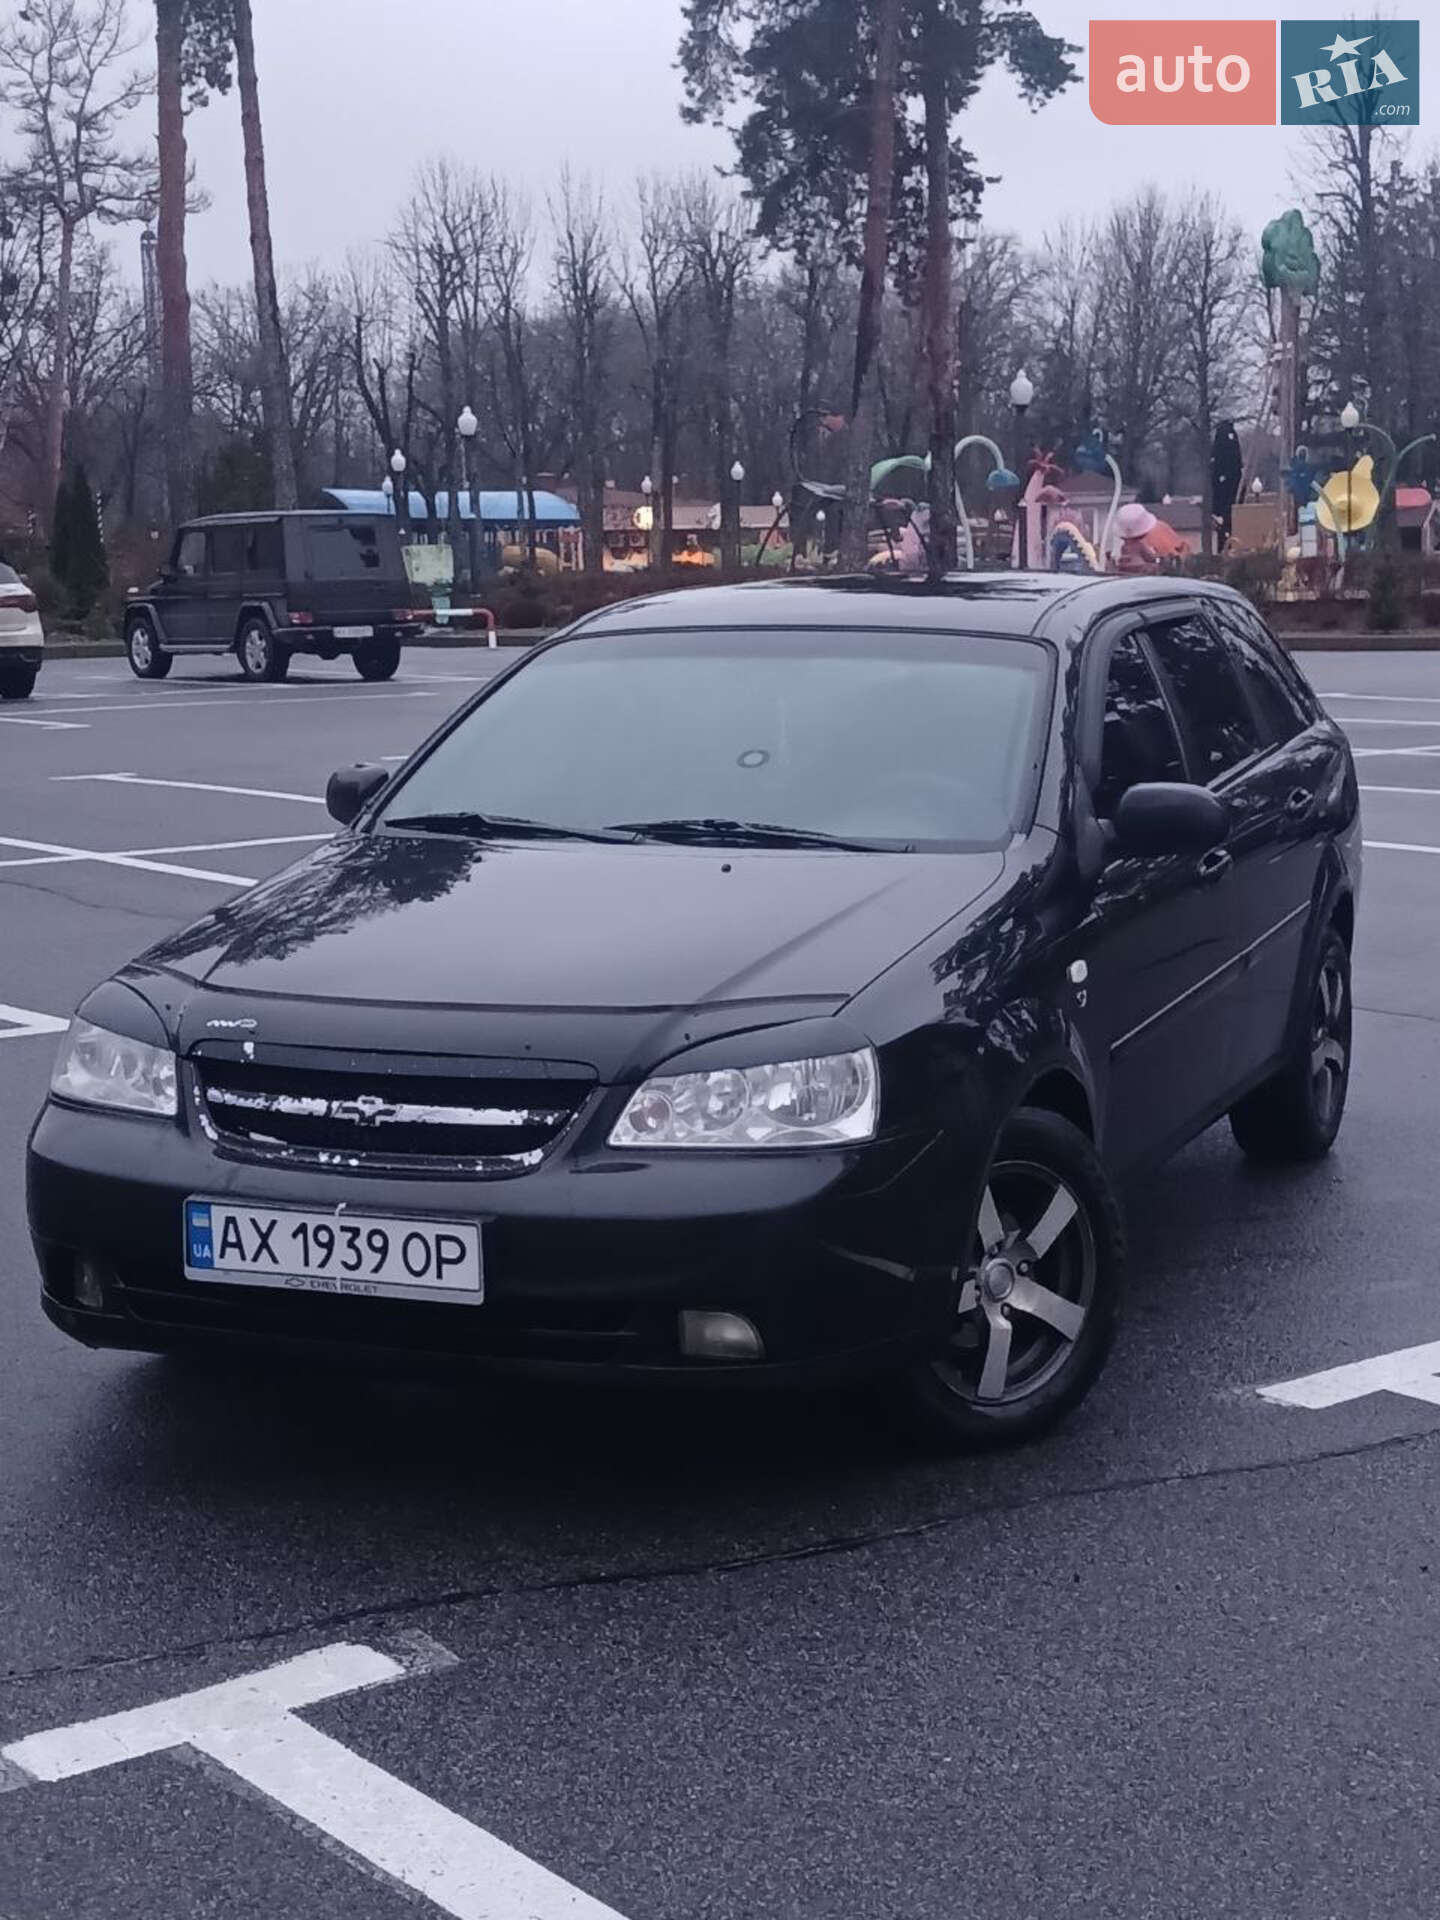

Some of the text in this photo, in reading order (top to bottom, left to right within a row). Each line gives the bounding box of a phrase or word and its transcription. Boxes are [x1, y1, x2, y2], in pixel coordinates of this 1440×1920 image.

[193, 1244, 211, 1258] UA
[219, 1216, 467, 1280] AX 1939 OP
